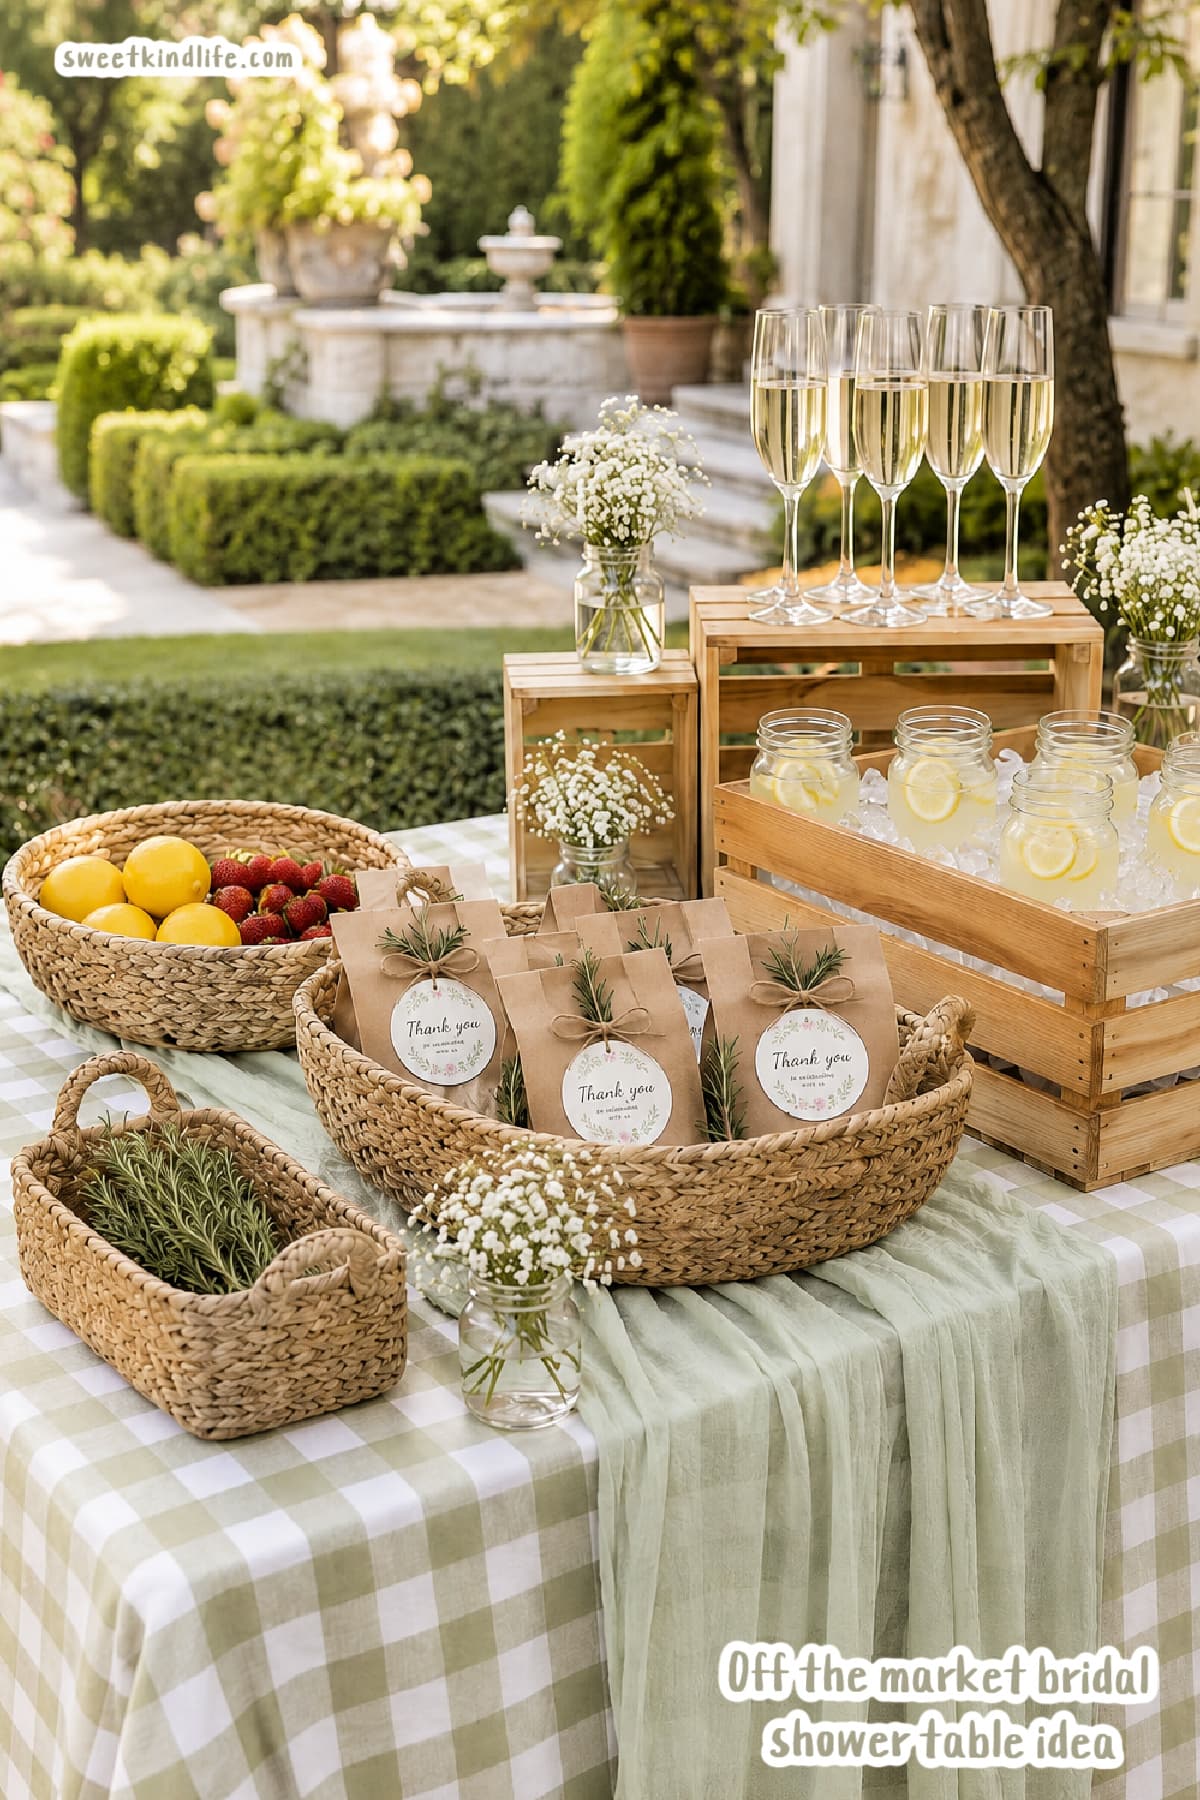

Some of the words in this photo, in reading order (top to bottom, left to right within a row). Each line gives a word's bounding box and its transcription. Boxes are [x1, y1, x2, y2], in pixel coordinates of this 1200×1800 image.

[406, 1016, 452, 1038] Thank
[455, 1019, 481, 1037] you
[773, 1048, 820, 1070] Thank
[825, 1053, 852, 1071] you
[577, 1080, 624, 1103] Thank
[629, 1083, 655, 1101] you
